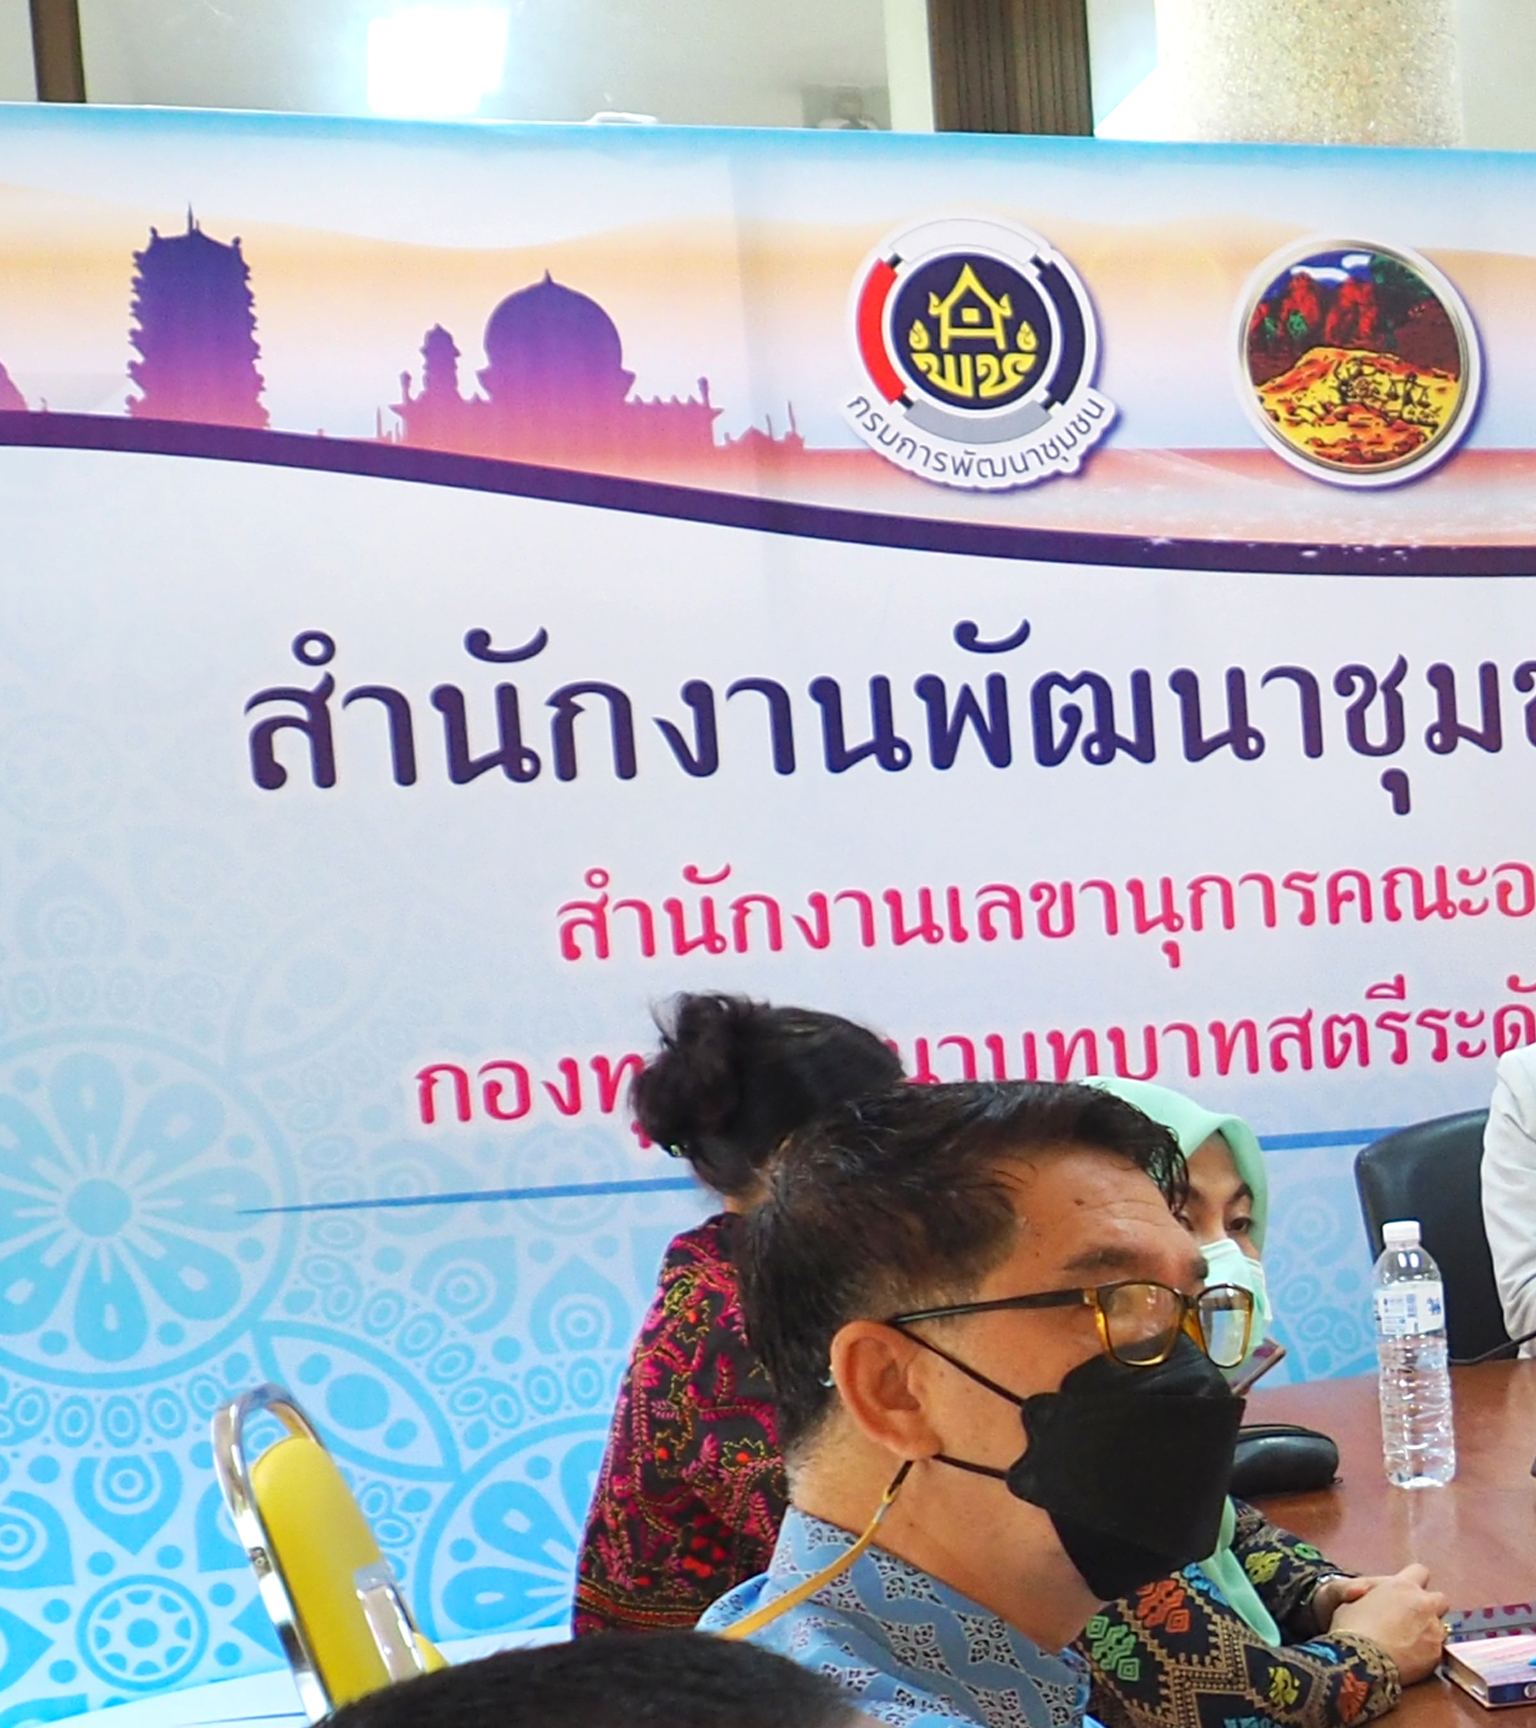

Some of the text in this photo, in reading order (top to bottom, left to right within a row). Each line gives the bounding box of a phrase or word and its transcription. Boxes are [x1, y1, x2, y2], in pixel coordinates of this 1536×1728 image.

[846, 396, 1106, 479] กรมการพัฒนาชุมชน
